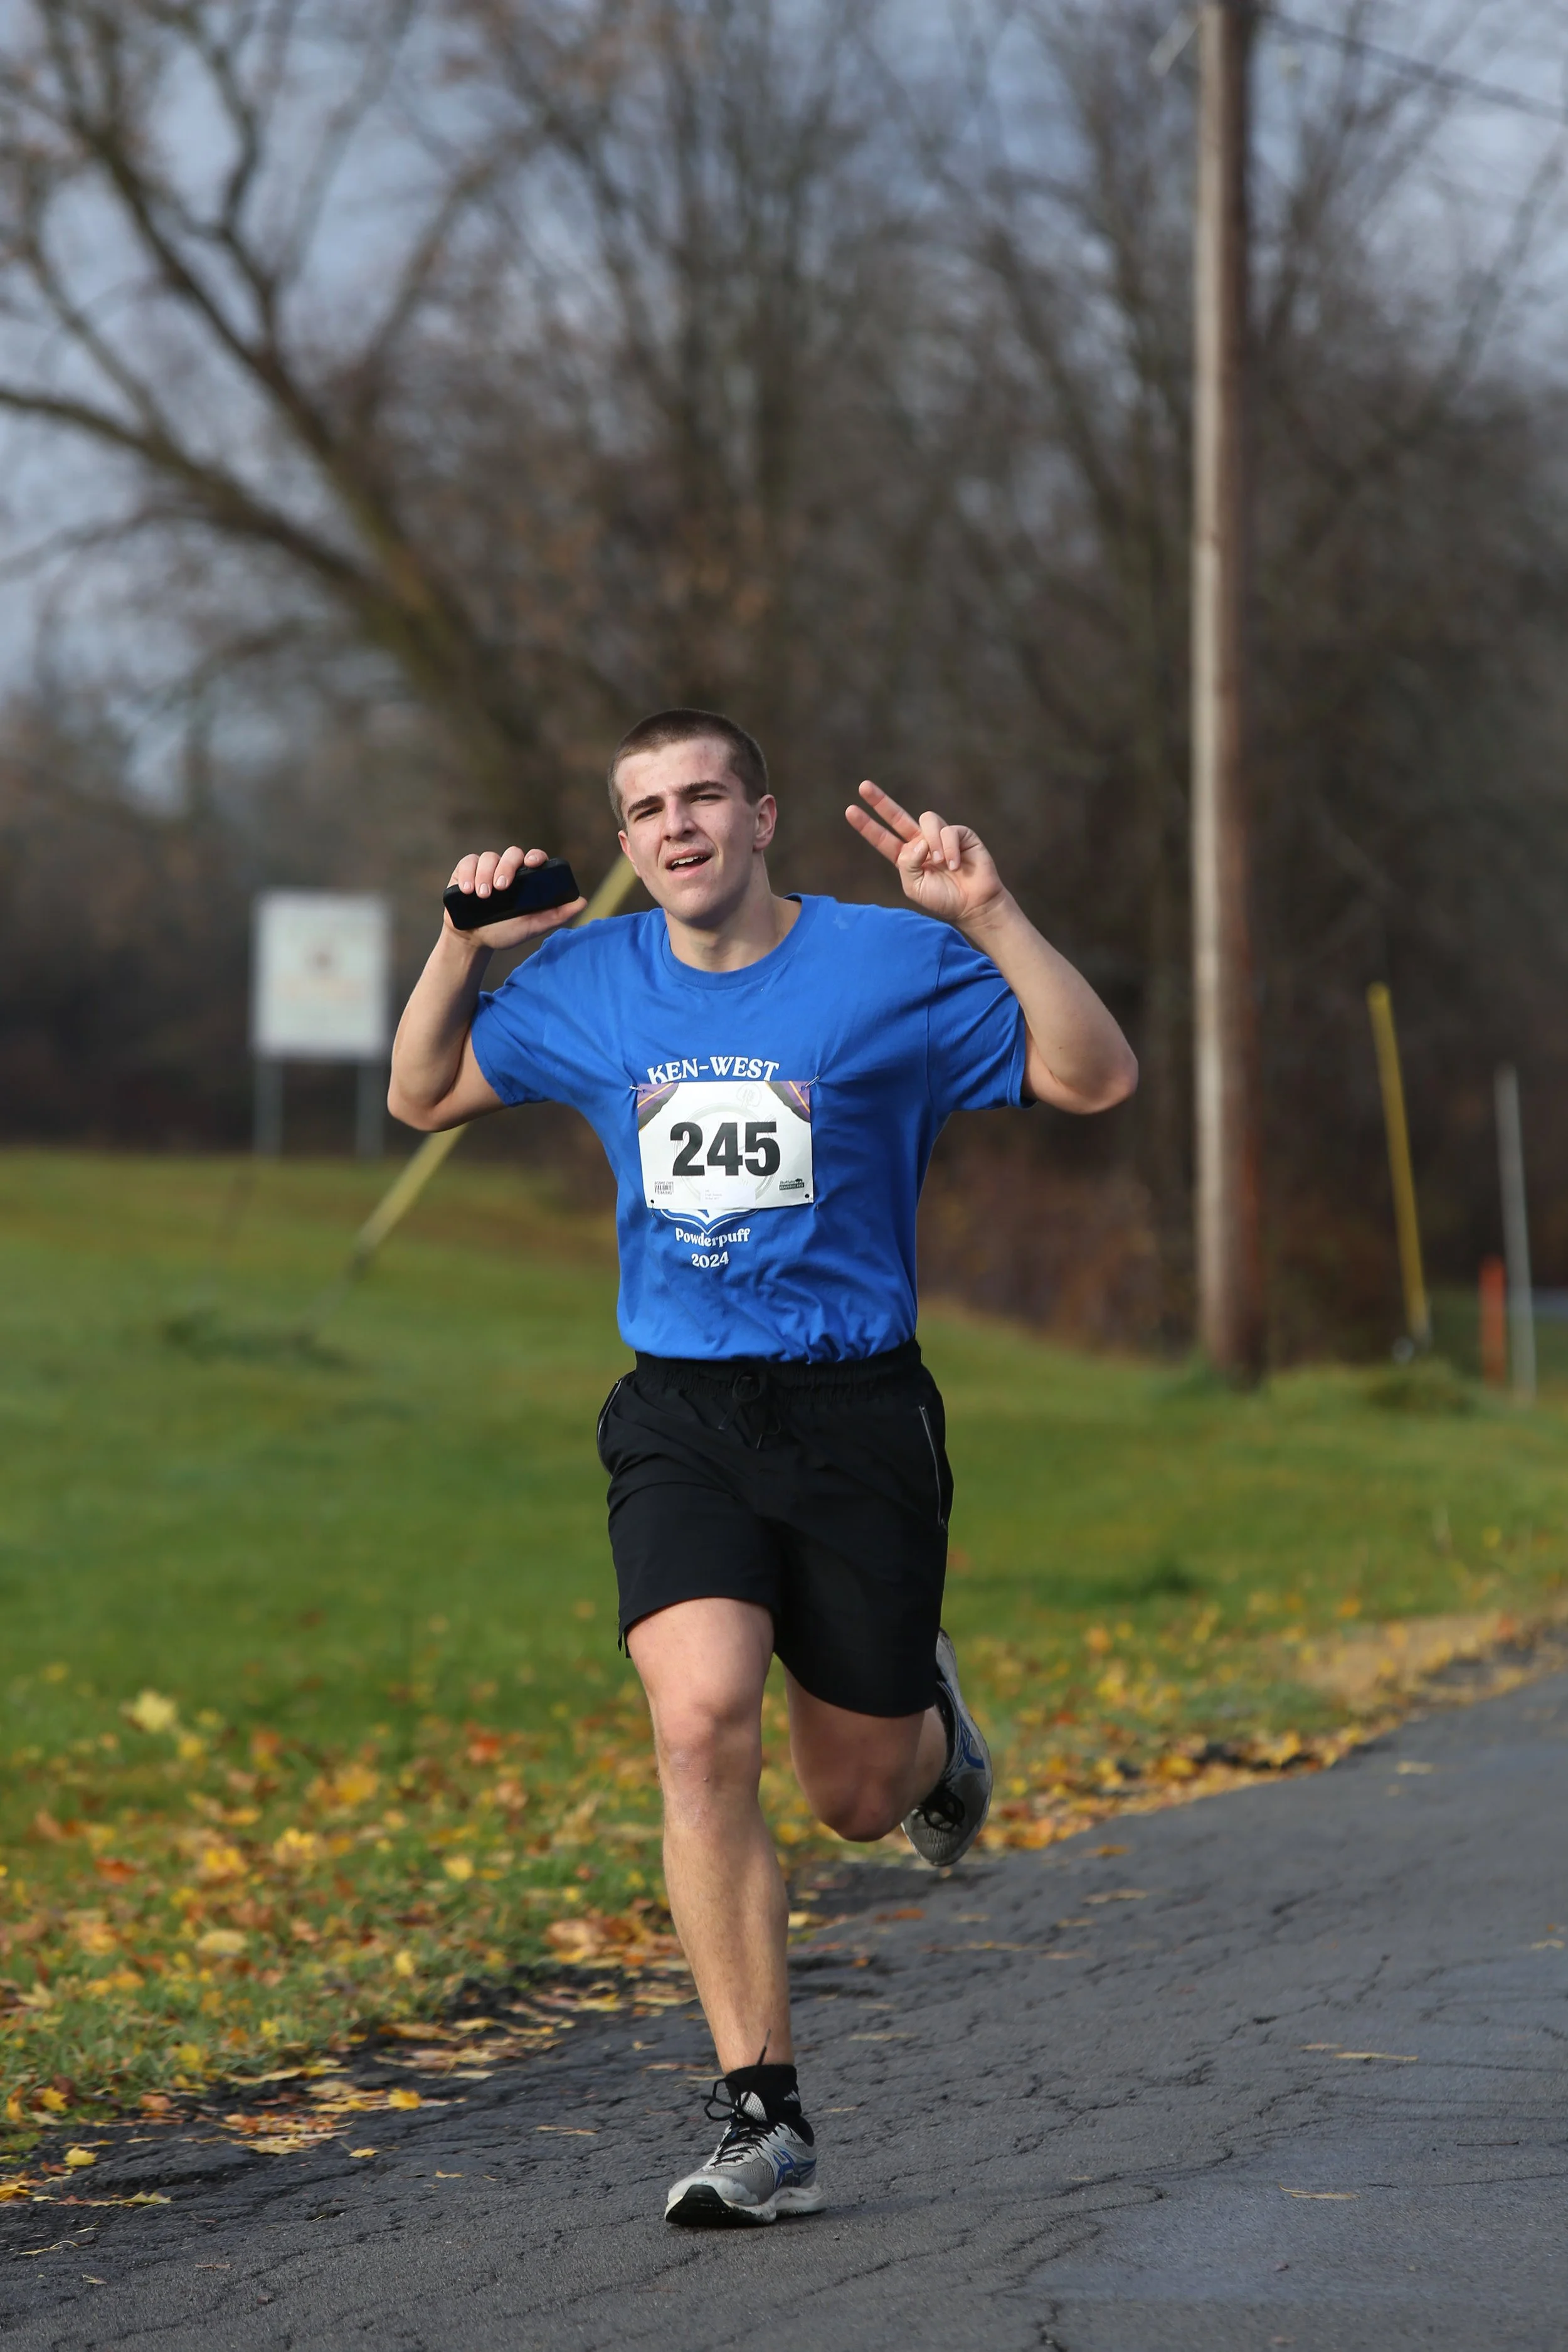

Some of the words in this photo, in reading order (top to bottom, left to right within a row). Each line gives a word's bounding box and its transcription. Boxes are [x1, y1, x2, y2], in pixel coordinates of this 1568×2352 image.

[647, 1056, 780, 1084] KEN-WEST
[670, 1122, 780, 1176] 245
[675, 1227, 751, 1248] Powderpuff
[691, 1251, 729, 1268] 2024
